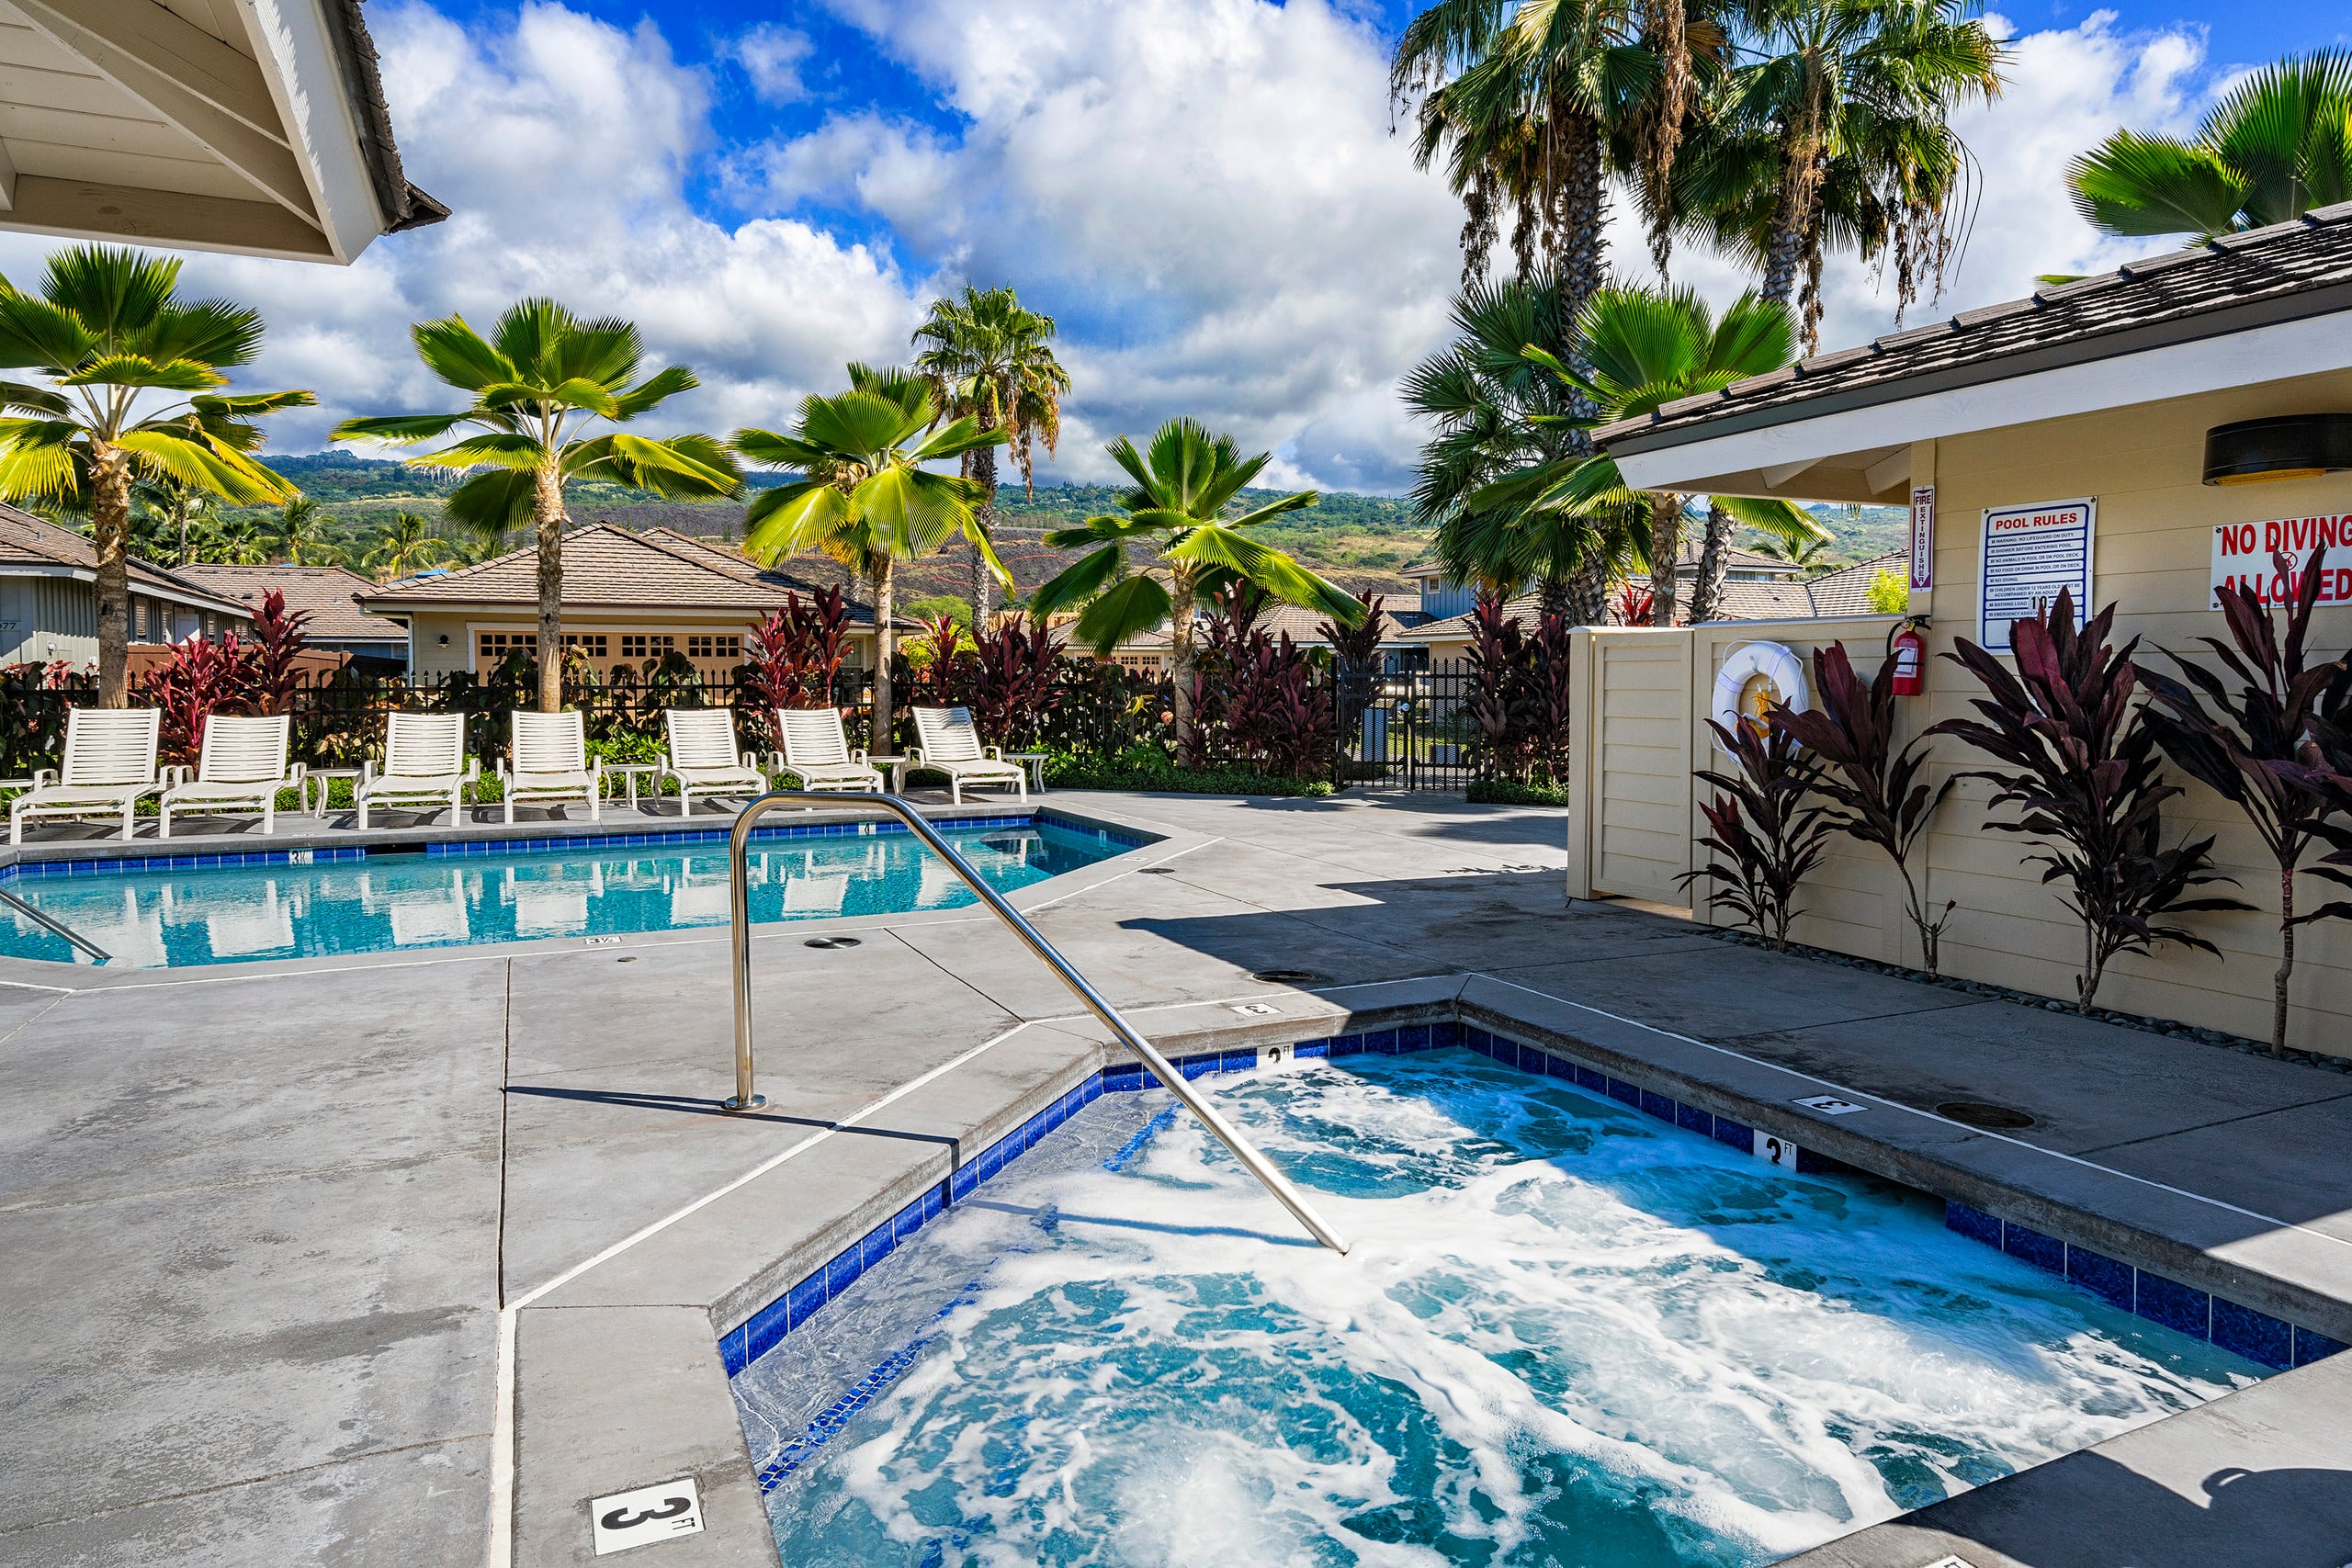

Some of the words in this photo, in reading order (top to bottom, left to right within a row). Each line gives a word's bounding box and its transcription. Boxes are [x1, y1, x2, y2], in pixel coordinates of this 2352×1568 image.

[1915, 495, 1931, 505] FIRE
[1996, 518, 2029, 530] POOL
[2033, 513, 2077, 527] RULES
[2222, 524, 2256, 556] NO
[2265, 515, 2352, 553] DIVING
[2031, 596, 2047, 609] 10
[1283, 1046, 1290, 1055] FT
[1812, 1101, 1850, 1109] 3
[1785, 1142, 1792, 1155] FT
[601, 1497, 691, 1530] 3
[672, 1517, 695, 1530] FT
